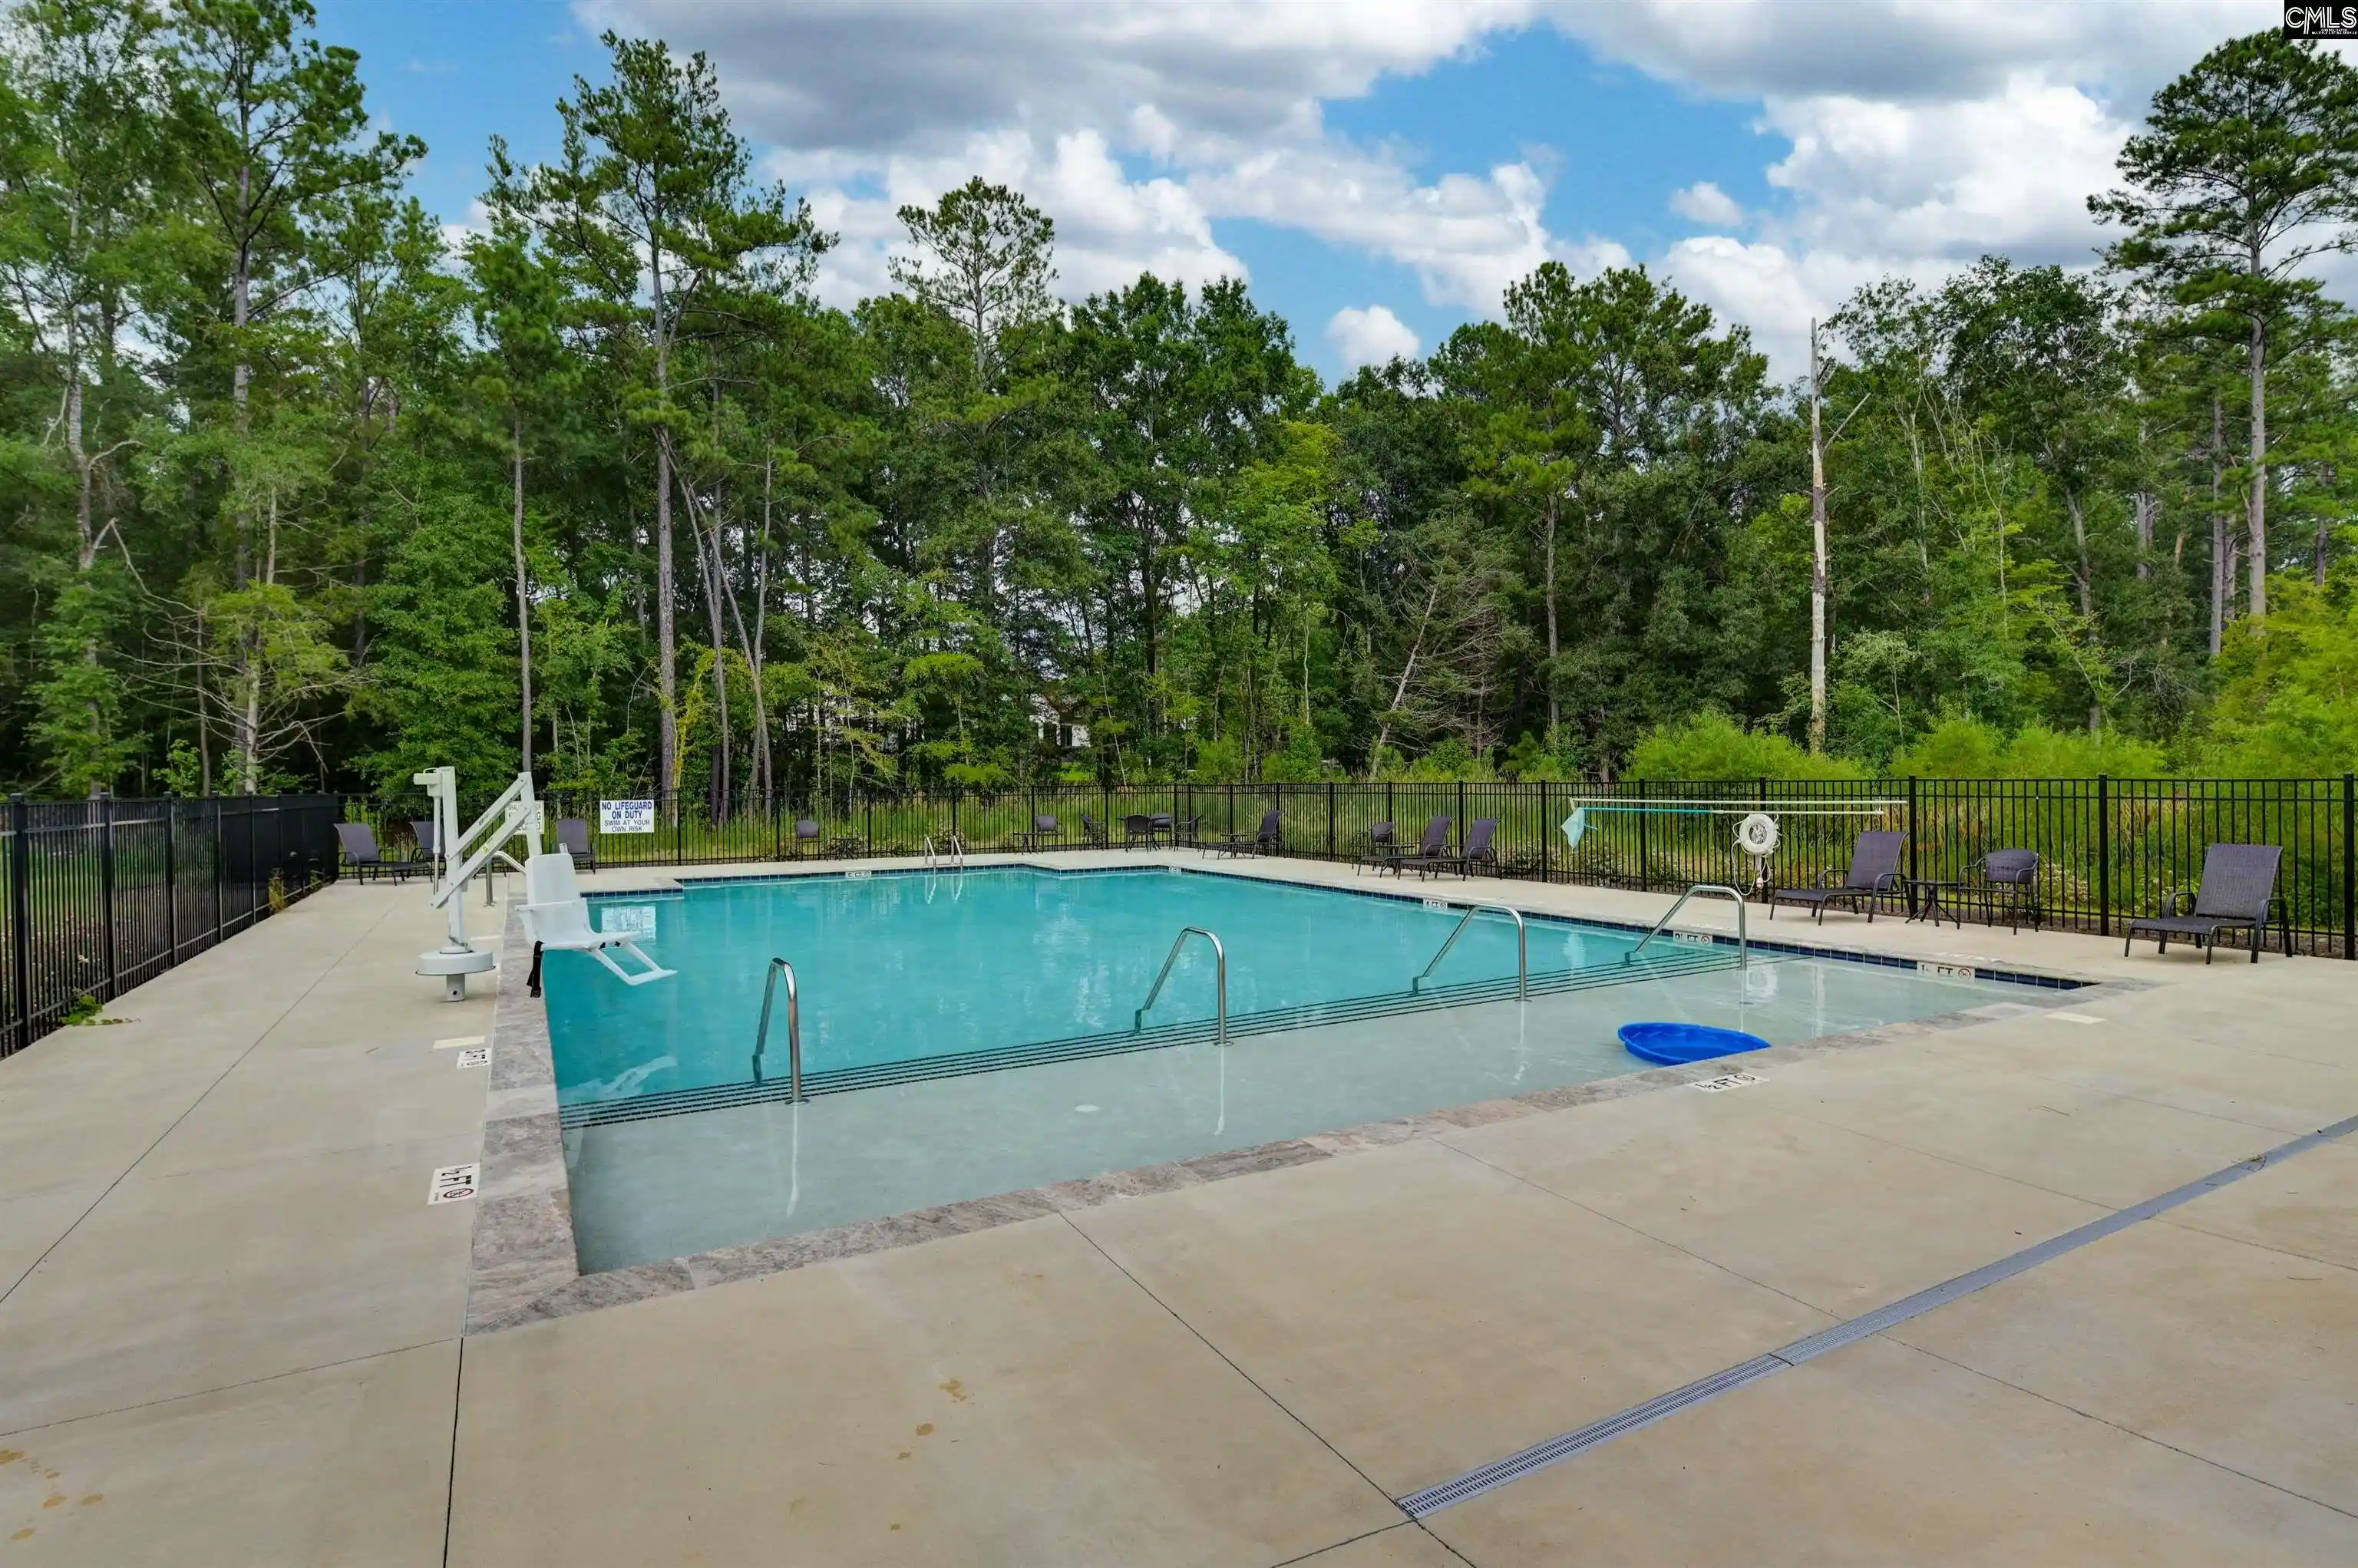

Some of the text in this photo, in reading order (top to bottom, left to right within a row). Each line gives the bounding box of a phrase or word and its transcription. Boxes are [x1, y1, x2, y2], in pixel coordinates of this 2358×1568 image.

[615, 801, 652, 810] LIFEGUARD
[612, 810, 642, 819] ON DUTY
[440, 1174, 471, 1188] FT
